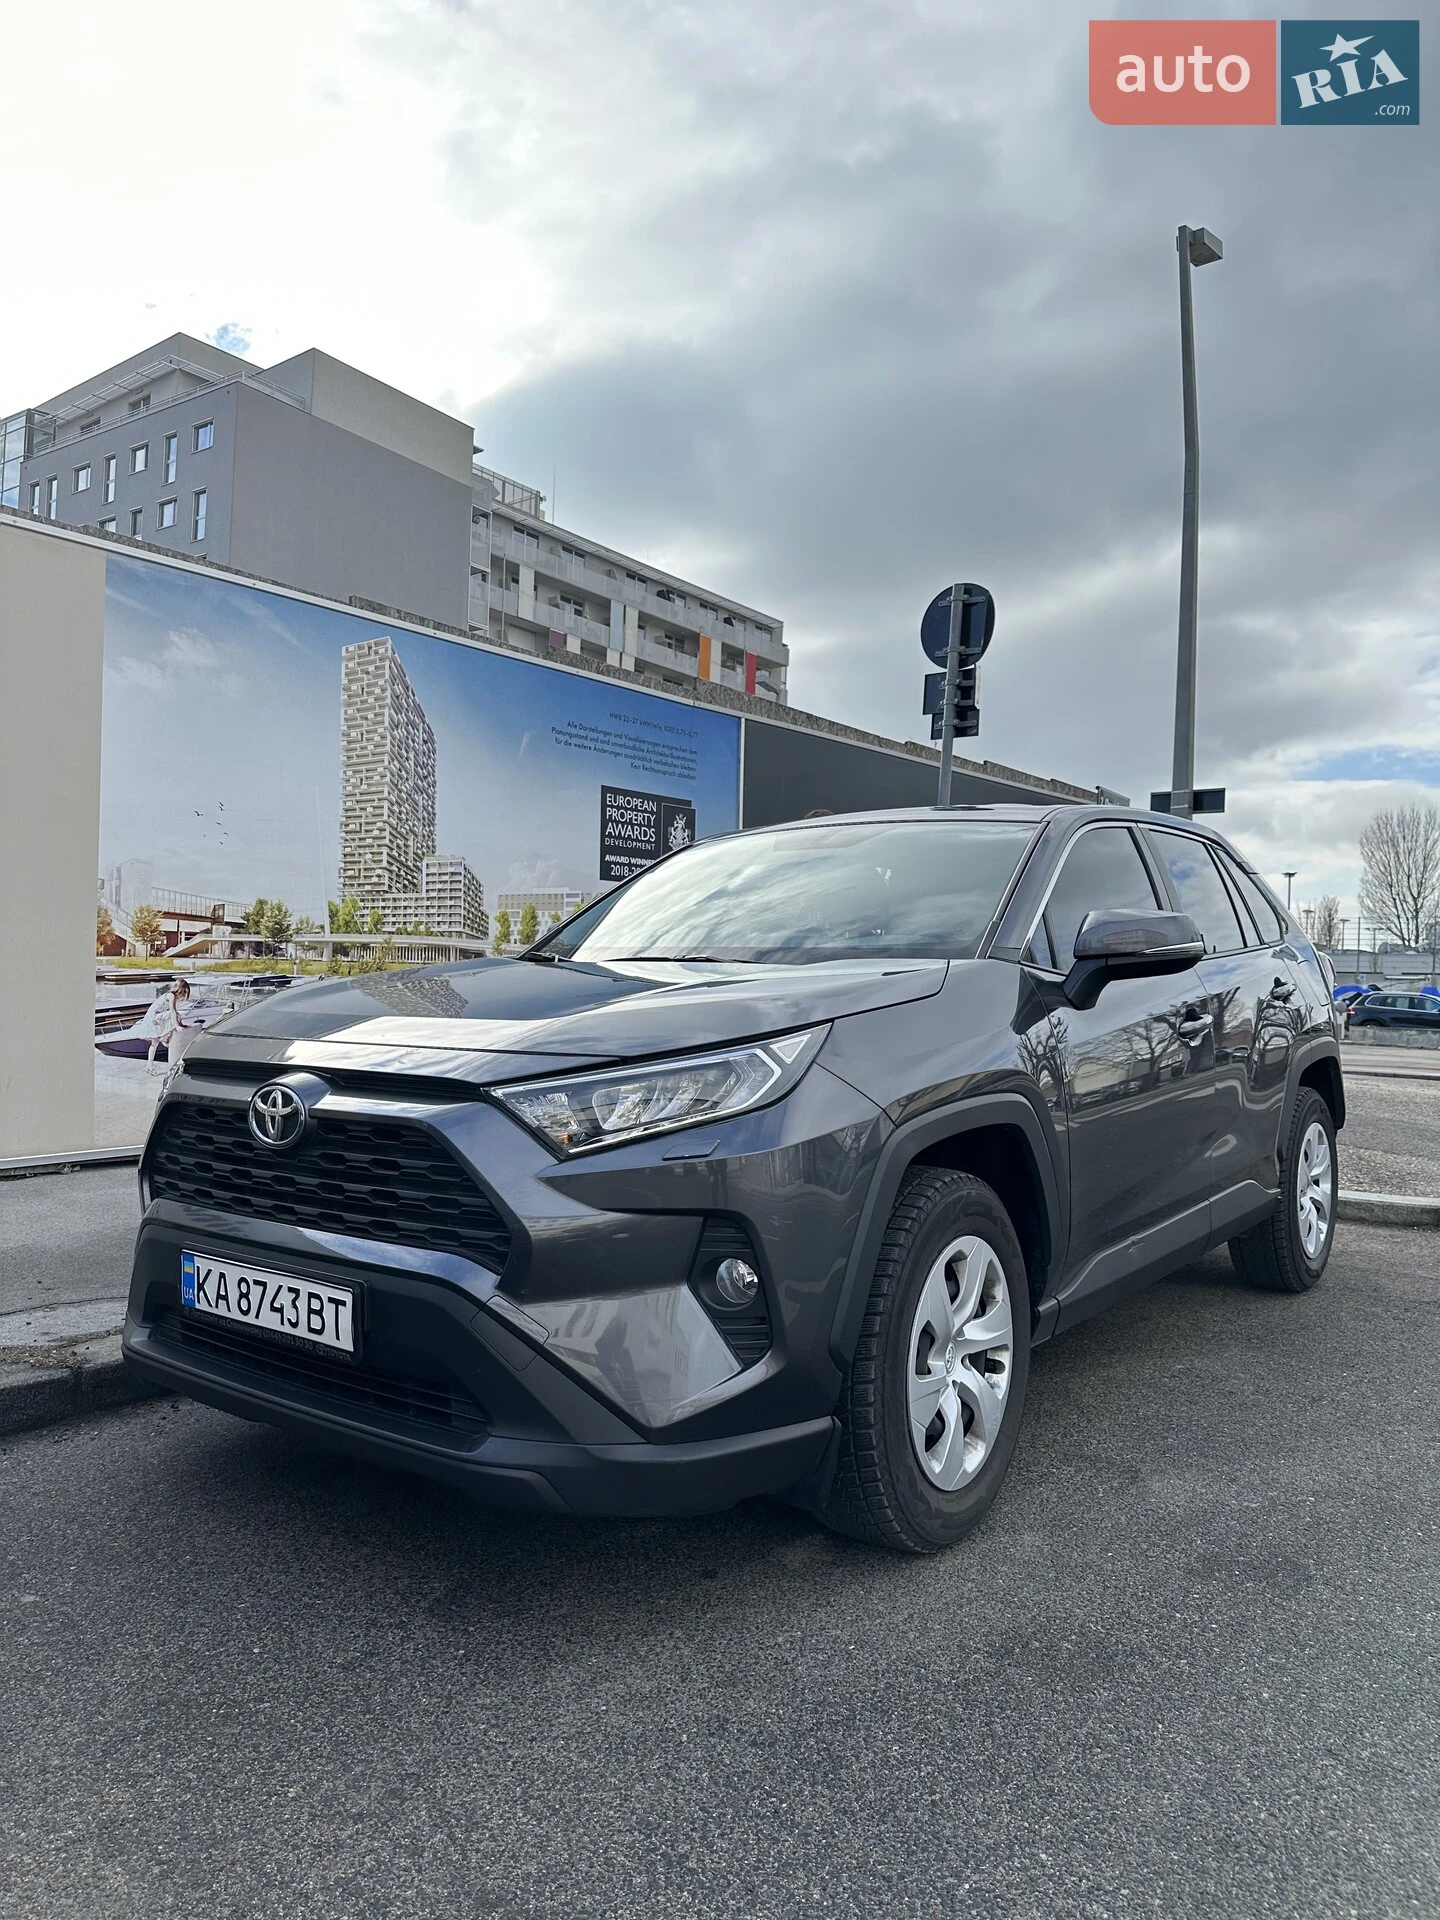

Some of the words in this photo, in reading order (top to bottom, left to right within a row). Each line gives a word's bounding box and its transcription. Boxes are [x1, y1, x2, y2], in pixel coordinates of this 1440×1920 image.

[552, 727, 588, 741] Planungsstand
[611, 740, 645, 752] unverbindliche
[567, 720, 578, 730] Alle
[578, 723, 613, 738] Darstellungen
[624, 734, 661, 748] Visualisierungen
[662, 744, 688, 754] entsprechen
[564, 740, 572, 748] die
[573, 742, 592, 751] weitere
[593, 746, 623, 758] Änderungen
[624, 753, 652, 764] ausdrücklich
[654, 759, 680, 768] vorbehalten
[630, 762, 642, 770] Kein
[642, 764, 676, 776] Rechtsanspruch
[606, 794, 656, 812] EUROPEAN
[606, 808, 656, 826] PROPERTY
[606, 822, 656, 842] AWARDS
[605, 838, 656, 850] DEVELOPMENT
[605, 854, 630, 864] AWARD
[184, 1286, 194, 1300] UA
[282, 1334, 294, 1344] 201
[295, 1338, 304, 1348] 30
[304, 1340, 313, 1350] 30
[326, 1347, 352, 1362] TOYOTA
